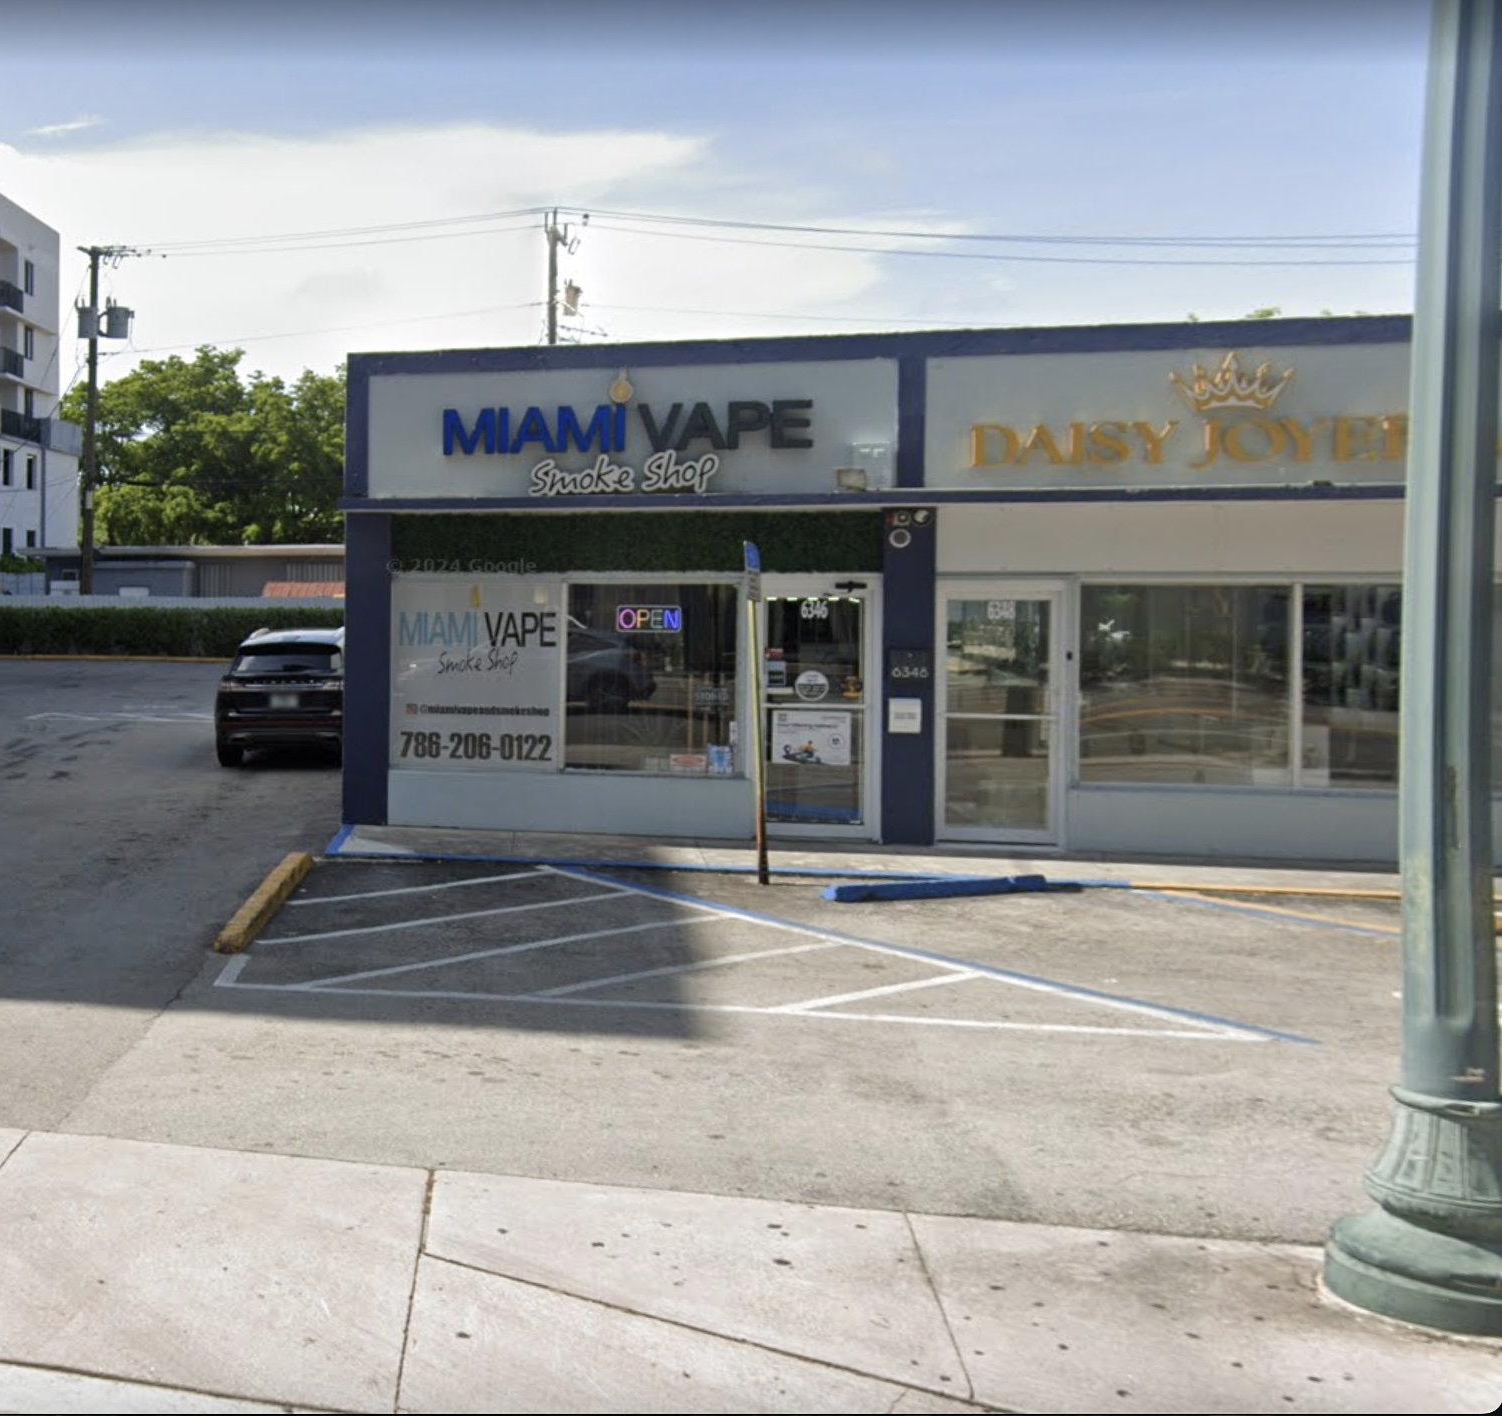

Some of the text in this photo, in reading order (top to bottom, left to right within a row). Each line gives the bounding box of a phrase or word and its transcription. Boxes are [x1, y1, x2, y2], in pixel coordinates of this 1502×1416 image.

[443, 399, 813, 456] MIAMI VAPE
[970, 419, 1179, 469] DAISY
[529, 450, 720, 496] Smoke Shop
[619, 608, 680, 629] OPEN
[801, 600, 828, 619] 6346
[399, 611, 557, 648] MIAMI VAPE
[437, 647, 519, 676] Smoke Shop
[400, 731, 552, 762] 786-206-0122
